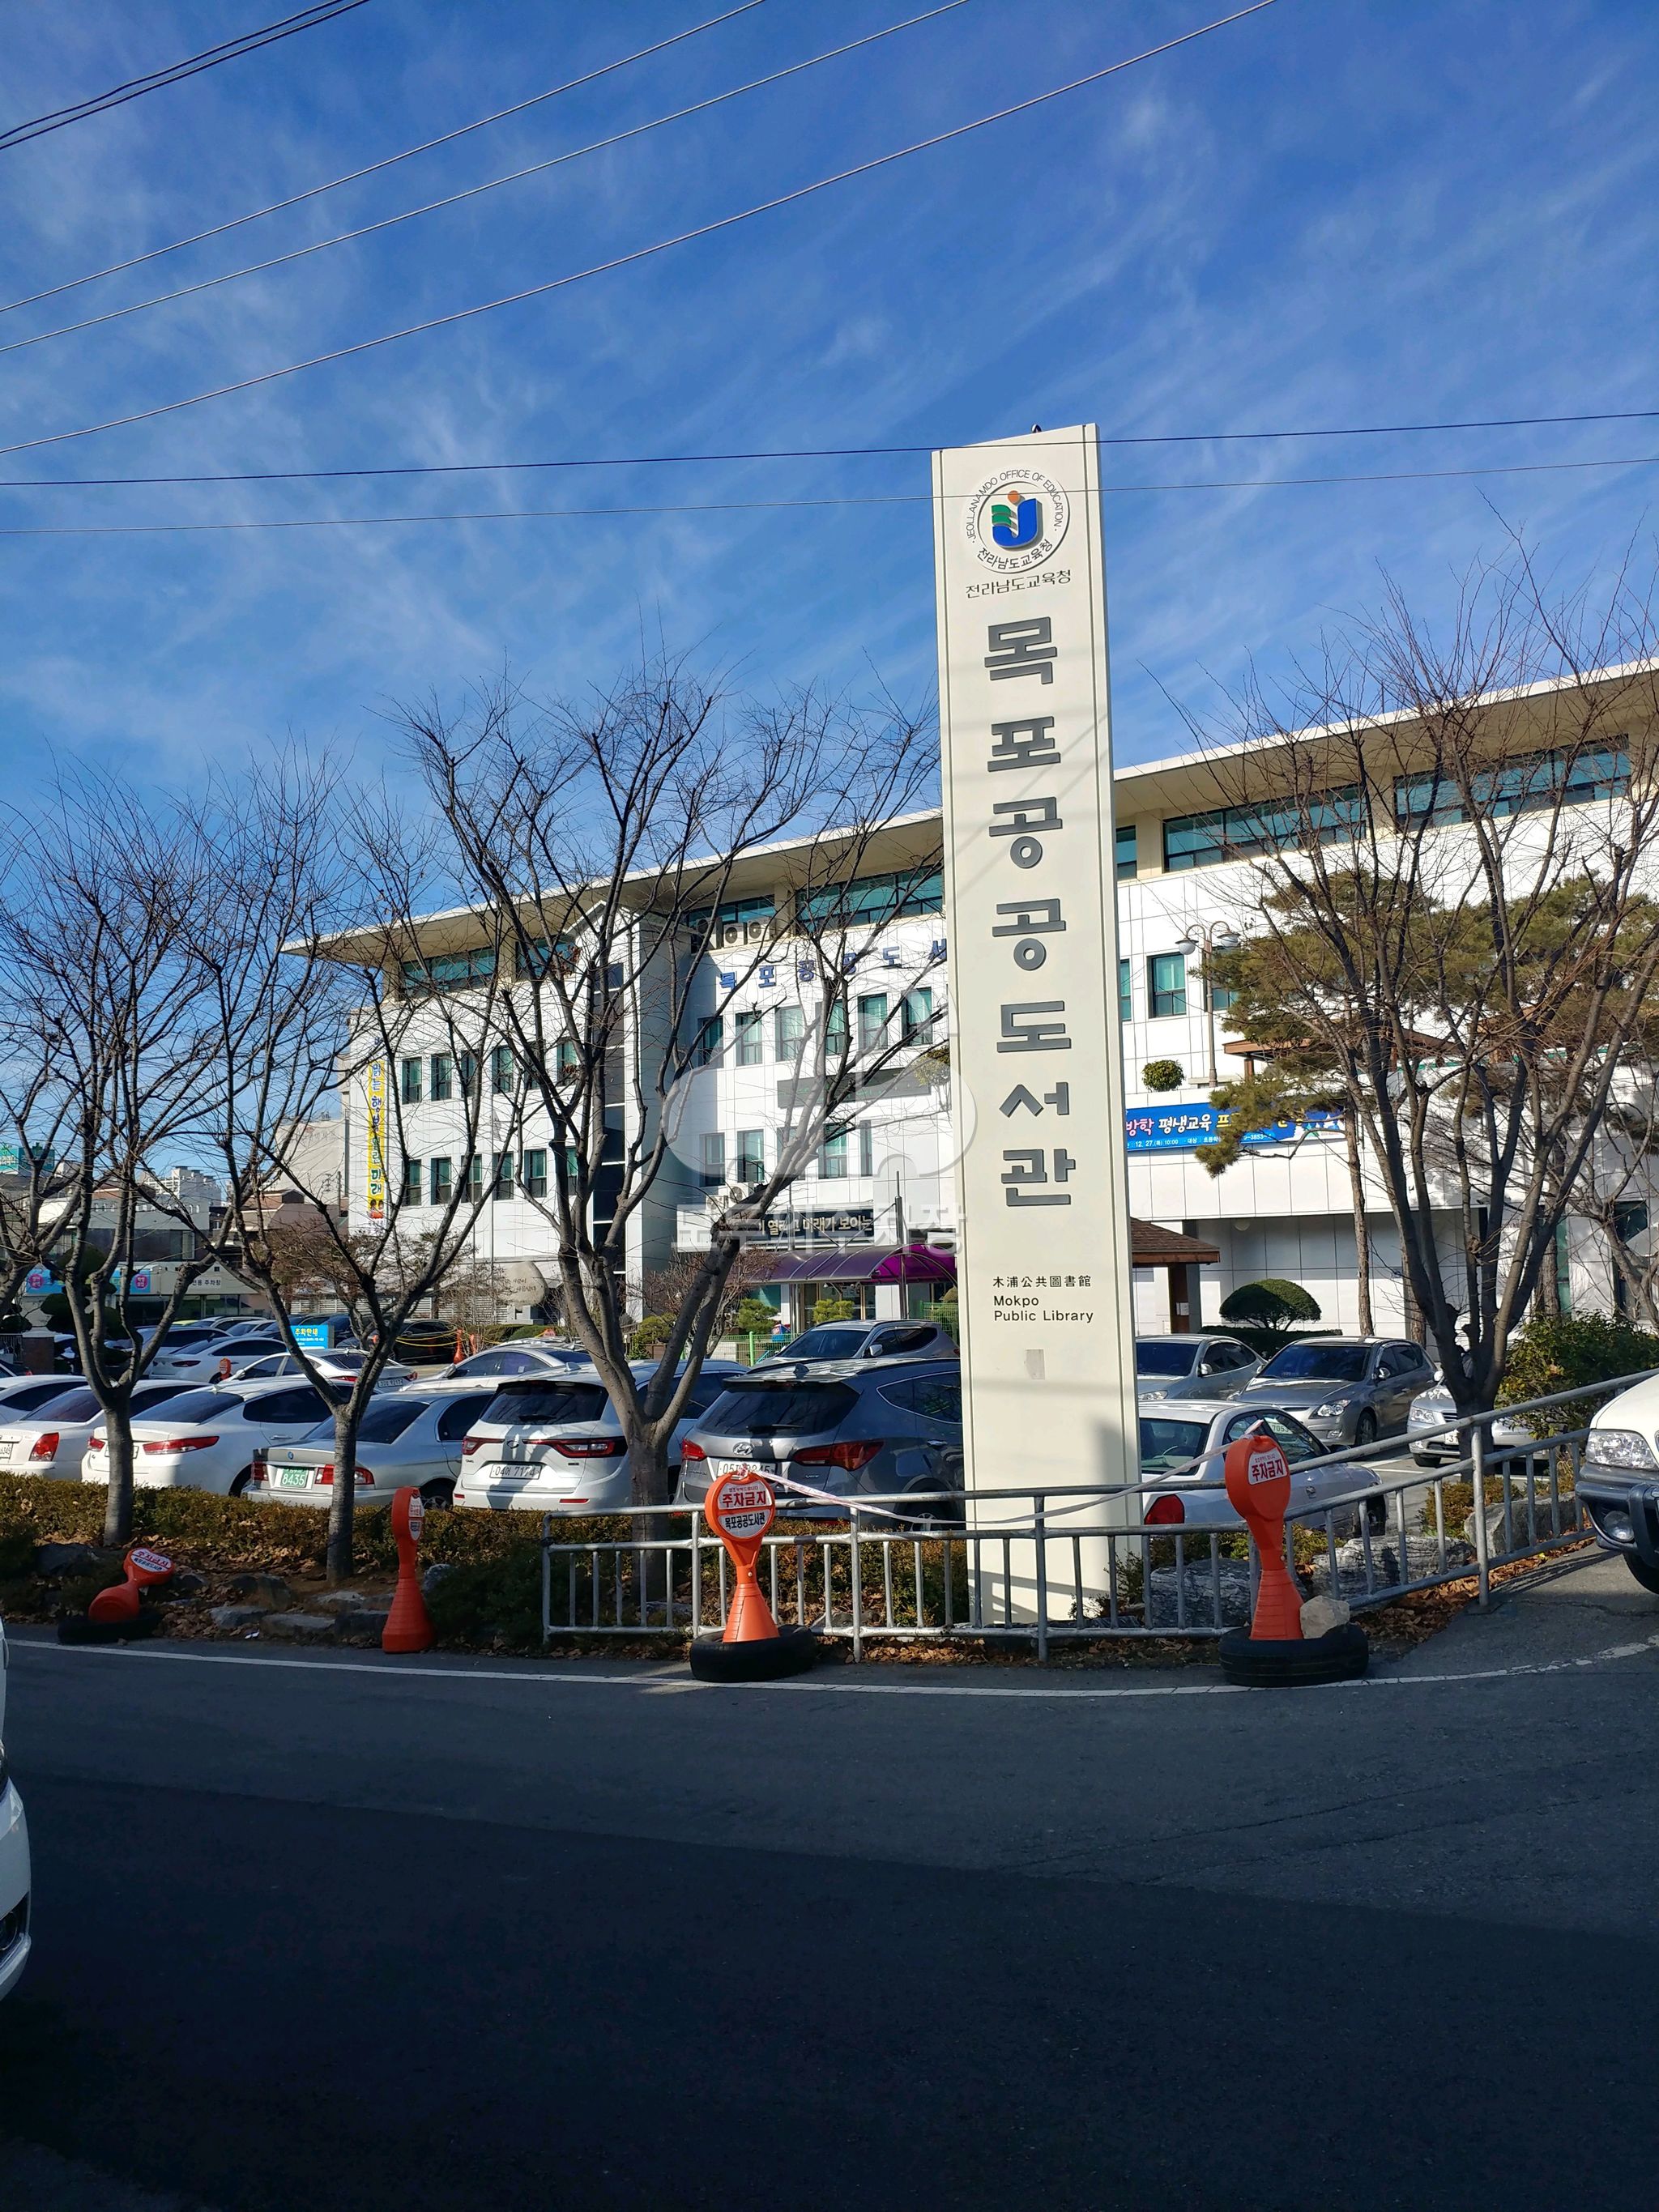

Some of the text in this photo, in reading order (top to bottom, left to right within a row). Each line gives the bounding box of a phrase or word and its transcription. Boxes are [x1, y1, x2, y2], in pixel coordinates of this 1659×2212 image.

[966, 469, 1064, 541] JEOLLANAMDO OFFICE OF EDUCATION
[977, 539, 1054, 569] 전라남도교육청
[966, 569, 1072, 599] 전라남도교육청
[984, 616, 1077, 1207] 목포공공도서관
[1158, 1114, 1212, 1134] 평생교육
[992, 1275, 1091, 1288] 木浦公共圖書館
[993, 1295, 1039, 1307] Mokpo
[994, 1310, 1094, 1323] Public Library
[282, 1473, 305, 1485] 8435
[1252, 1459, 1284, 1481] 주차금지
[723, 1490, 766, 1507] 주차금지
[725, 1511, 766, 1529] 목포공공도서관
